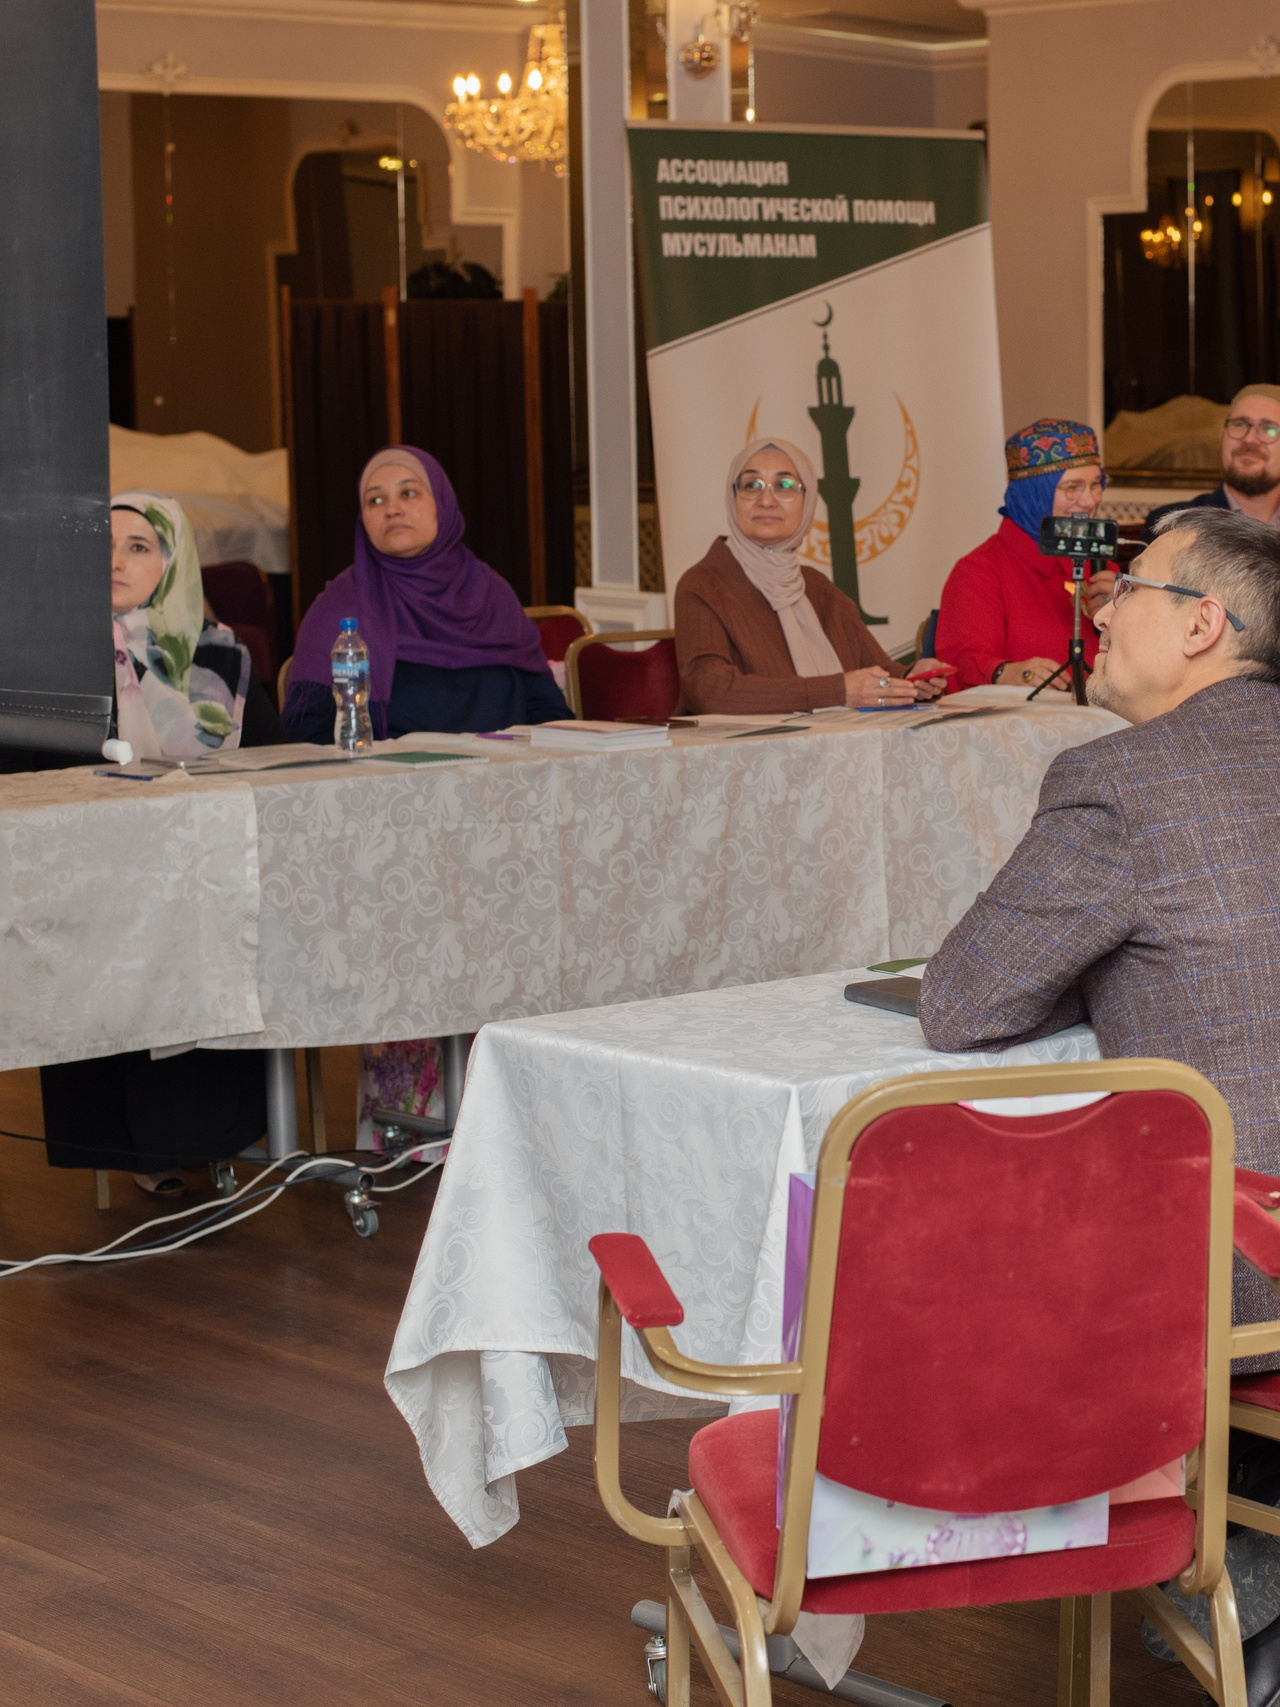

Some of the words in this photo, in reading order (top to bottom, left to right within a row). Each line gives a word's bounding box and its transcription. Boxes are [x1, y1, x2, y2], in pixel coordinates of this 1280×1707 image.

[656, 158, 789, 187] АССОЦИАЦИЯ
[658, 194, 849, 223] ПСИХОЛОГИЧЕСКОЙ
[852, 200, 936, 227] ПОМОЩИ
[661, 232, 818, 259] МУСУЛЬМАНАМ
